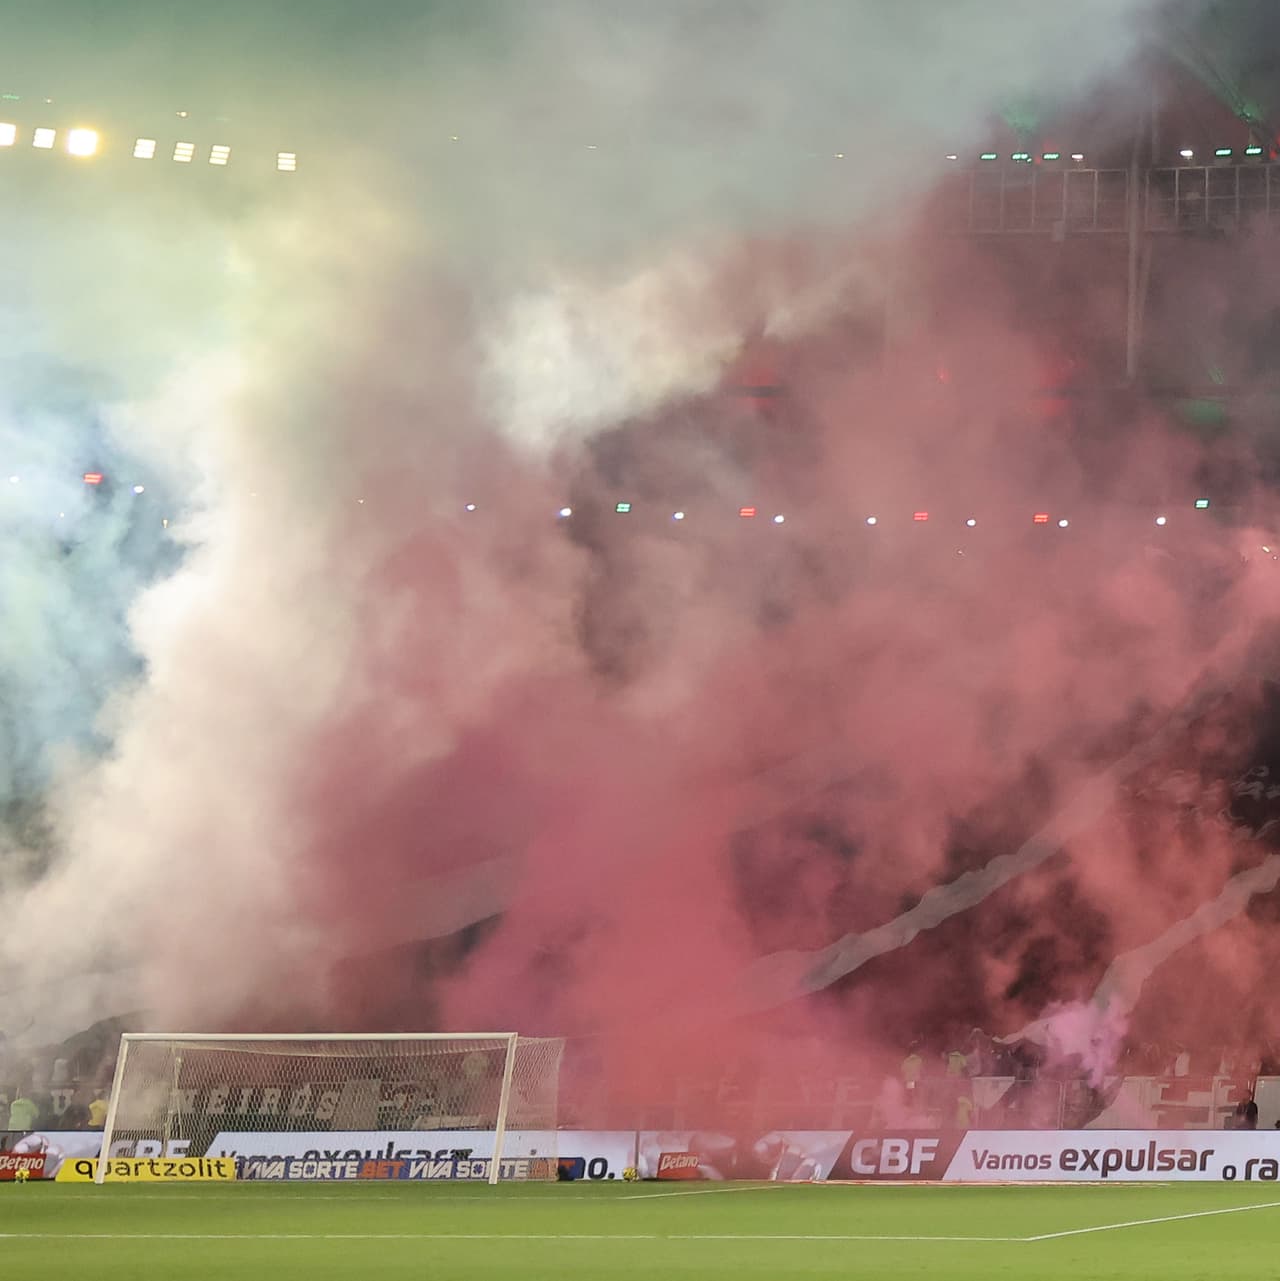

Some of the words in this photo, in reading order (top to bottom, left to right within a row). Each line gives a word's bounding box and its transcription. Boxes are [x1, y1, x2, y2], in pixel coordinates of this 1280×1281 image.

[660, 1154, 698, 1170] Betano
[850, 1138, 939, 1175] CBF
[972, 1149, 1052, 1170] Vamos
[1059, 1141, 1214, 1178] expulsar
[1222, 1164, 1237, 1181] o
[289, 1160, 359, 1179] SORTE
[359, 1161, 405, 1179] BET
[408, 1160, 452, 1179] VIVA
